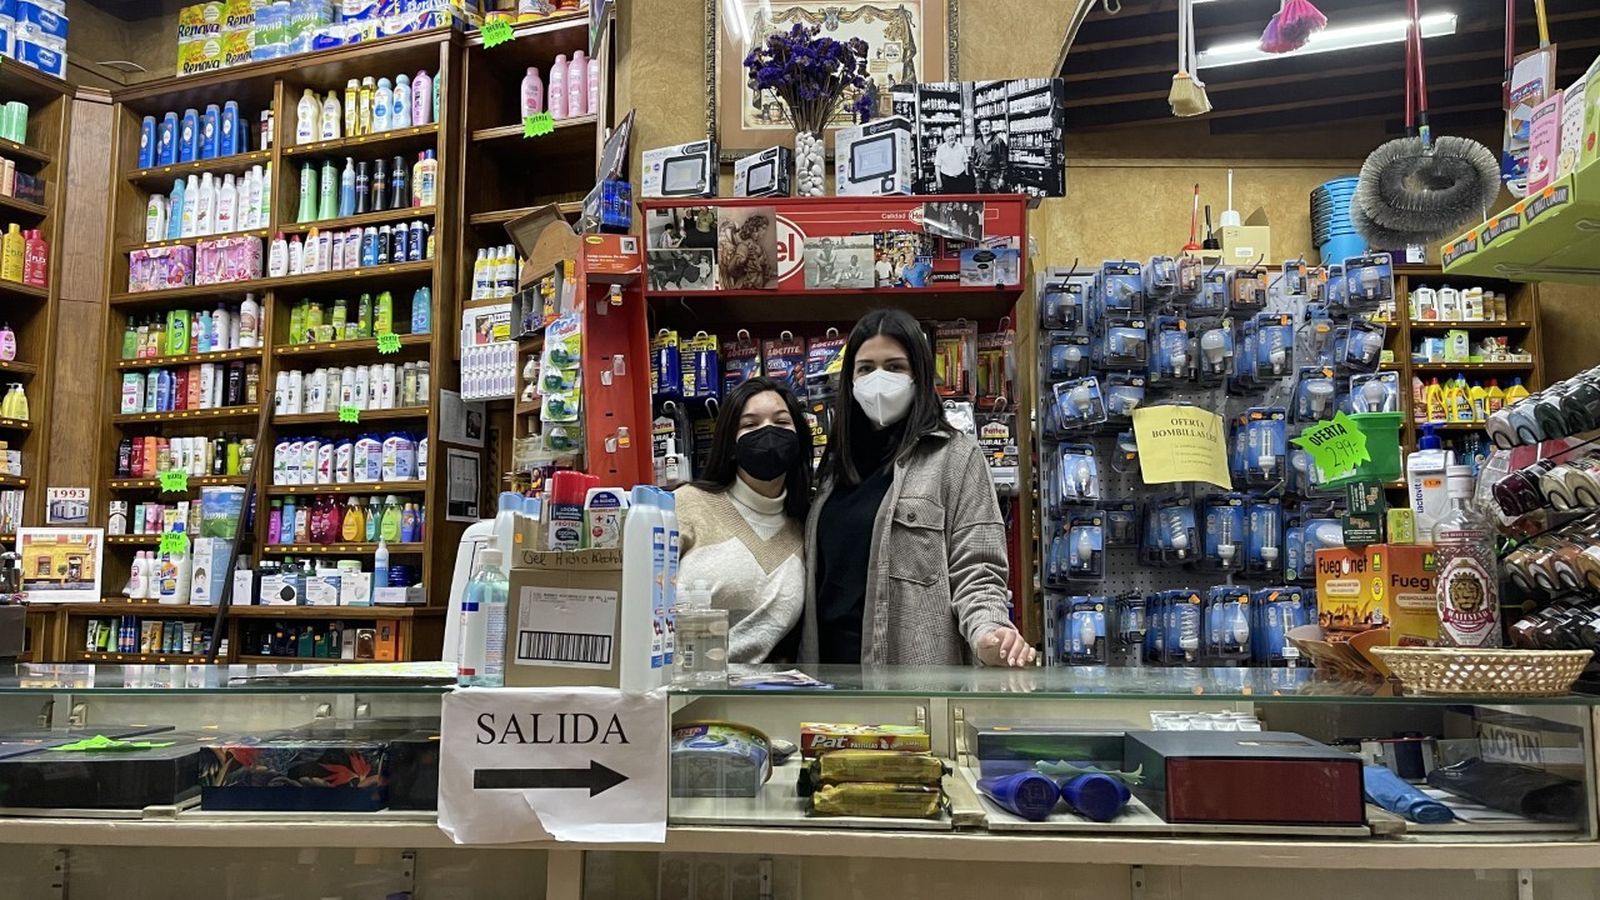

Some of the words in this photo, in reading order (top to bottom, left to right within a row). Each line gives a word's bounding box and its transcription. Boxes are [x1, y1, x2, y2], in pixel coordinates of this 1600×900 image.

[177, 23, 219, 38] Renova
[183, 59, 220, 74] Renova
[881, 212, 906, 221] Calidad
[32, 255, 46, 263] FLEX
[768, 345, 801, 356] LOCTITE
[652, 422, 674, 430] Pattex
[1170, 418, 1205, 428] OFERTA
[811, 427, 823, 436] 20
[983, 427, 1006, 435] Pattex
[1152, 428, 1206, 439] BOMBILLAS
[1308, 423, 1348, 447] OFERTA
[53, 489, 85, 499] 1993
[523, 550, 547, 565] Gel
[476, 713, 630, 745] SALIDA
[811, 734, 848, 749] Pat
[1484, 727, 1543, 764] JOTUN
